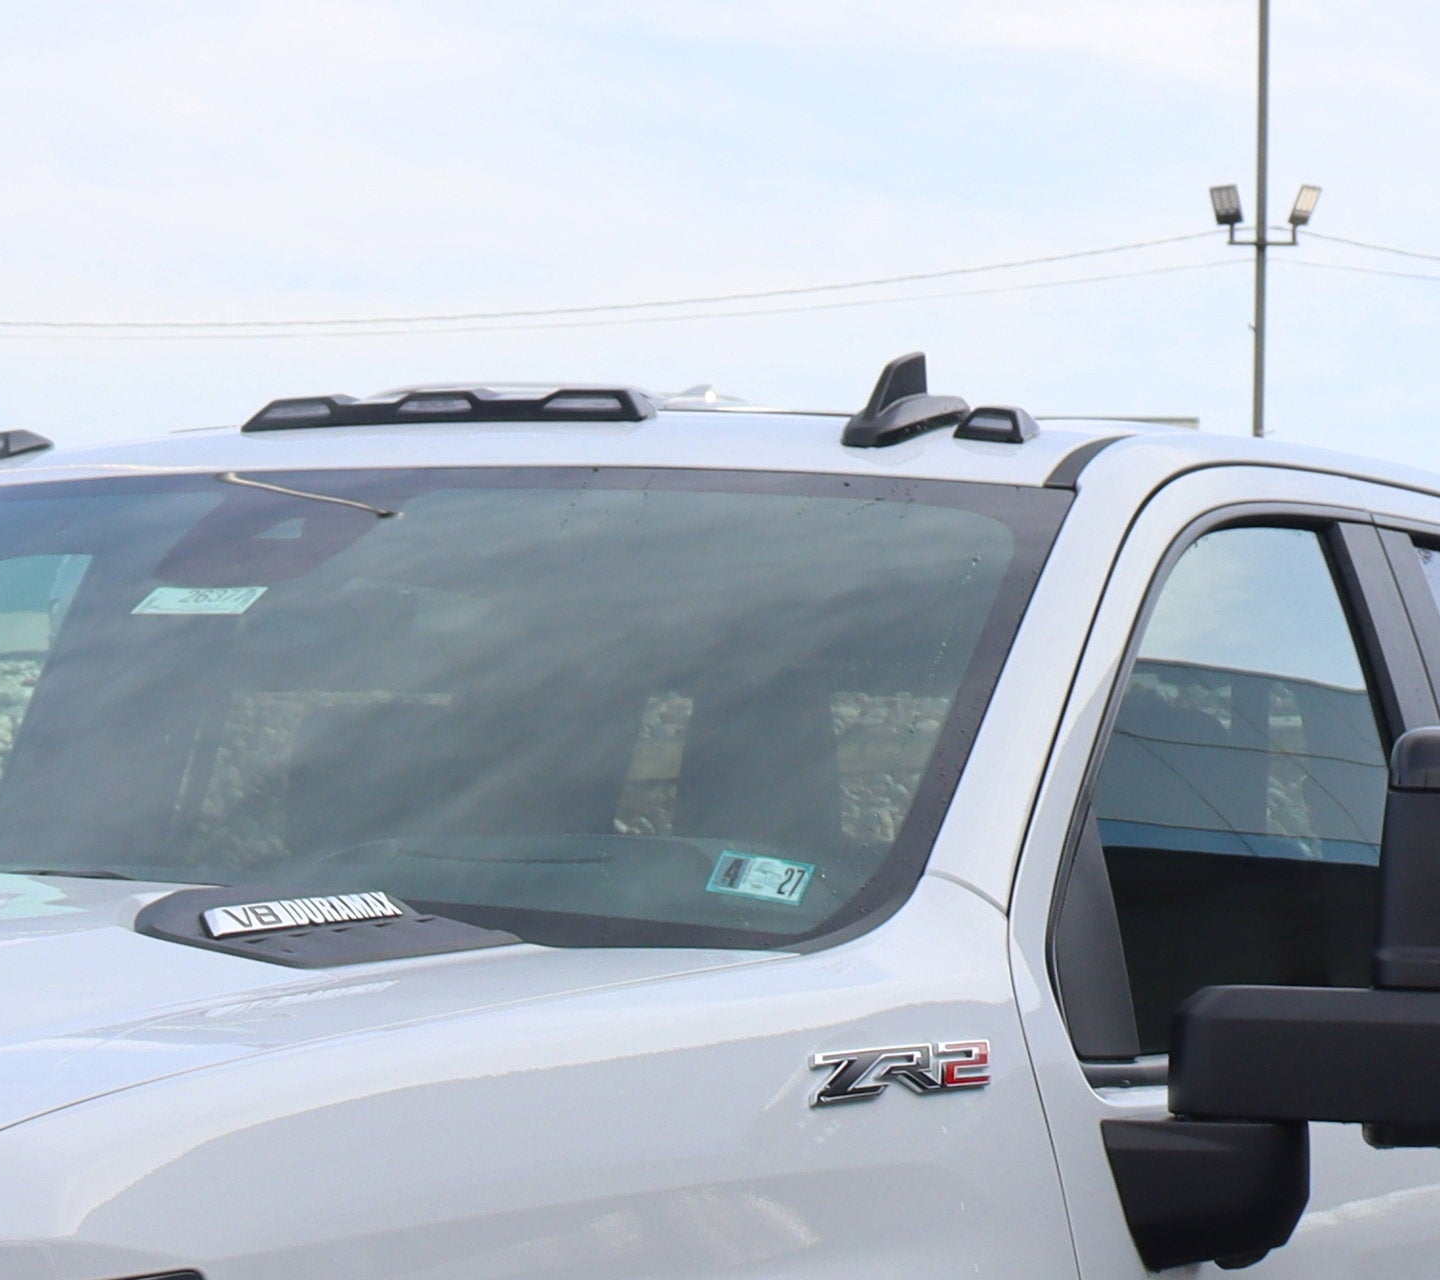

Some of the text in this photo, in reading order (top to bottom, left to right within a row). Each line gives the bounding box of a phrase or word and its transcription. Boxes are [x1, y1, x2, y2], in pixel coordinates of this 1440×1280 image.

[723, 859, 745, 888] 4
[777, 867, 806, 897] 27
[221, 891, 404, 928] V8 DURAMAX
[809, 1039, 991, 1109] ZR2
